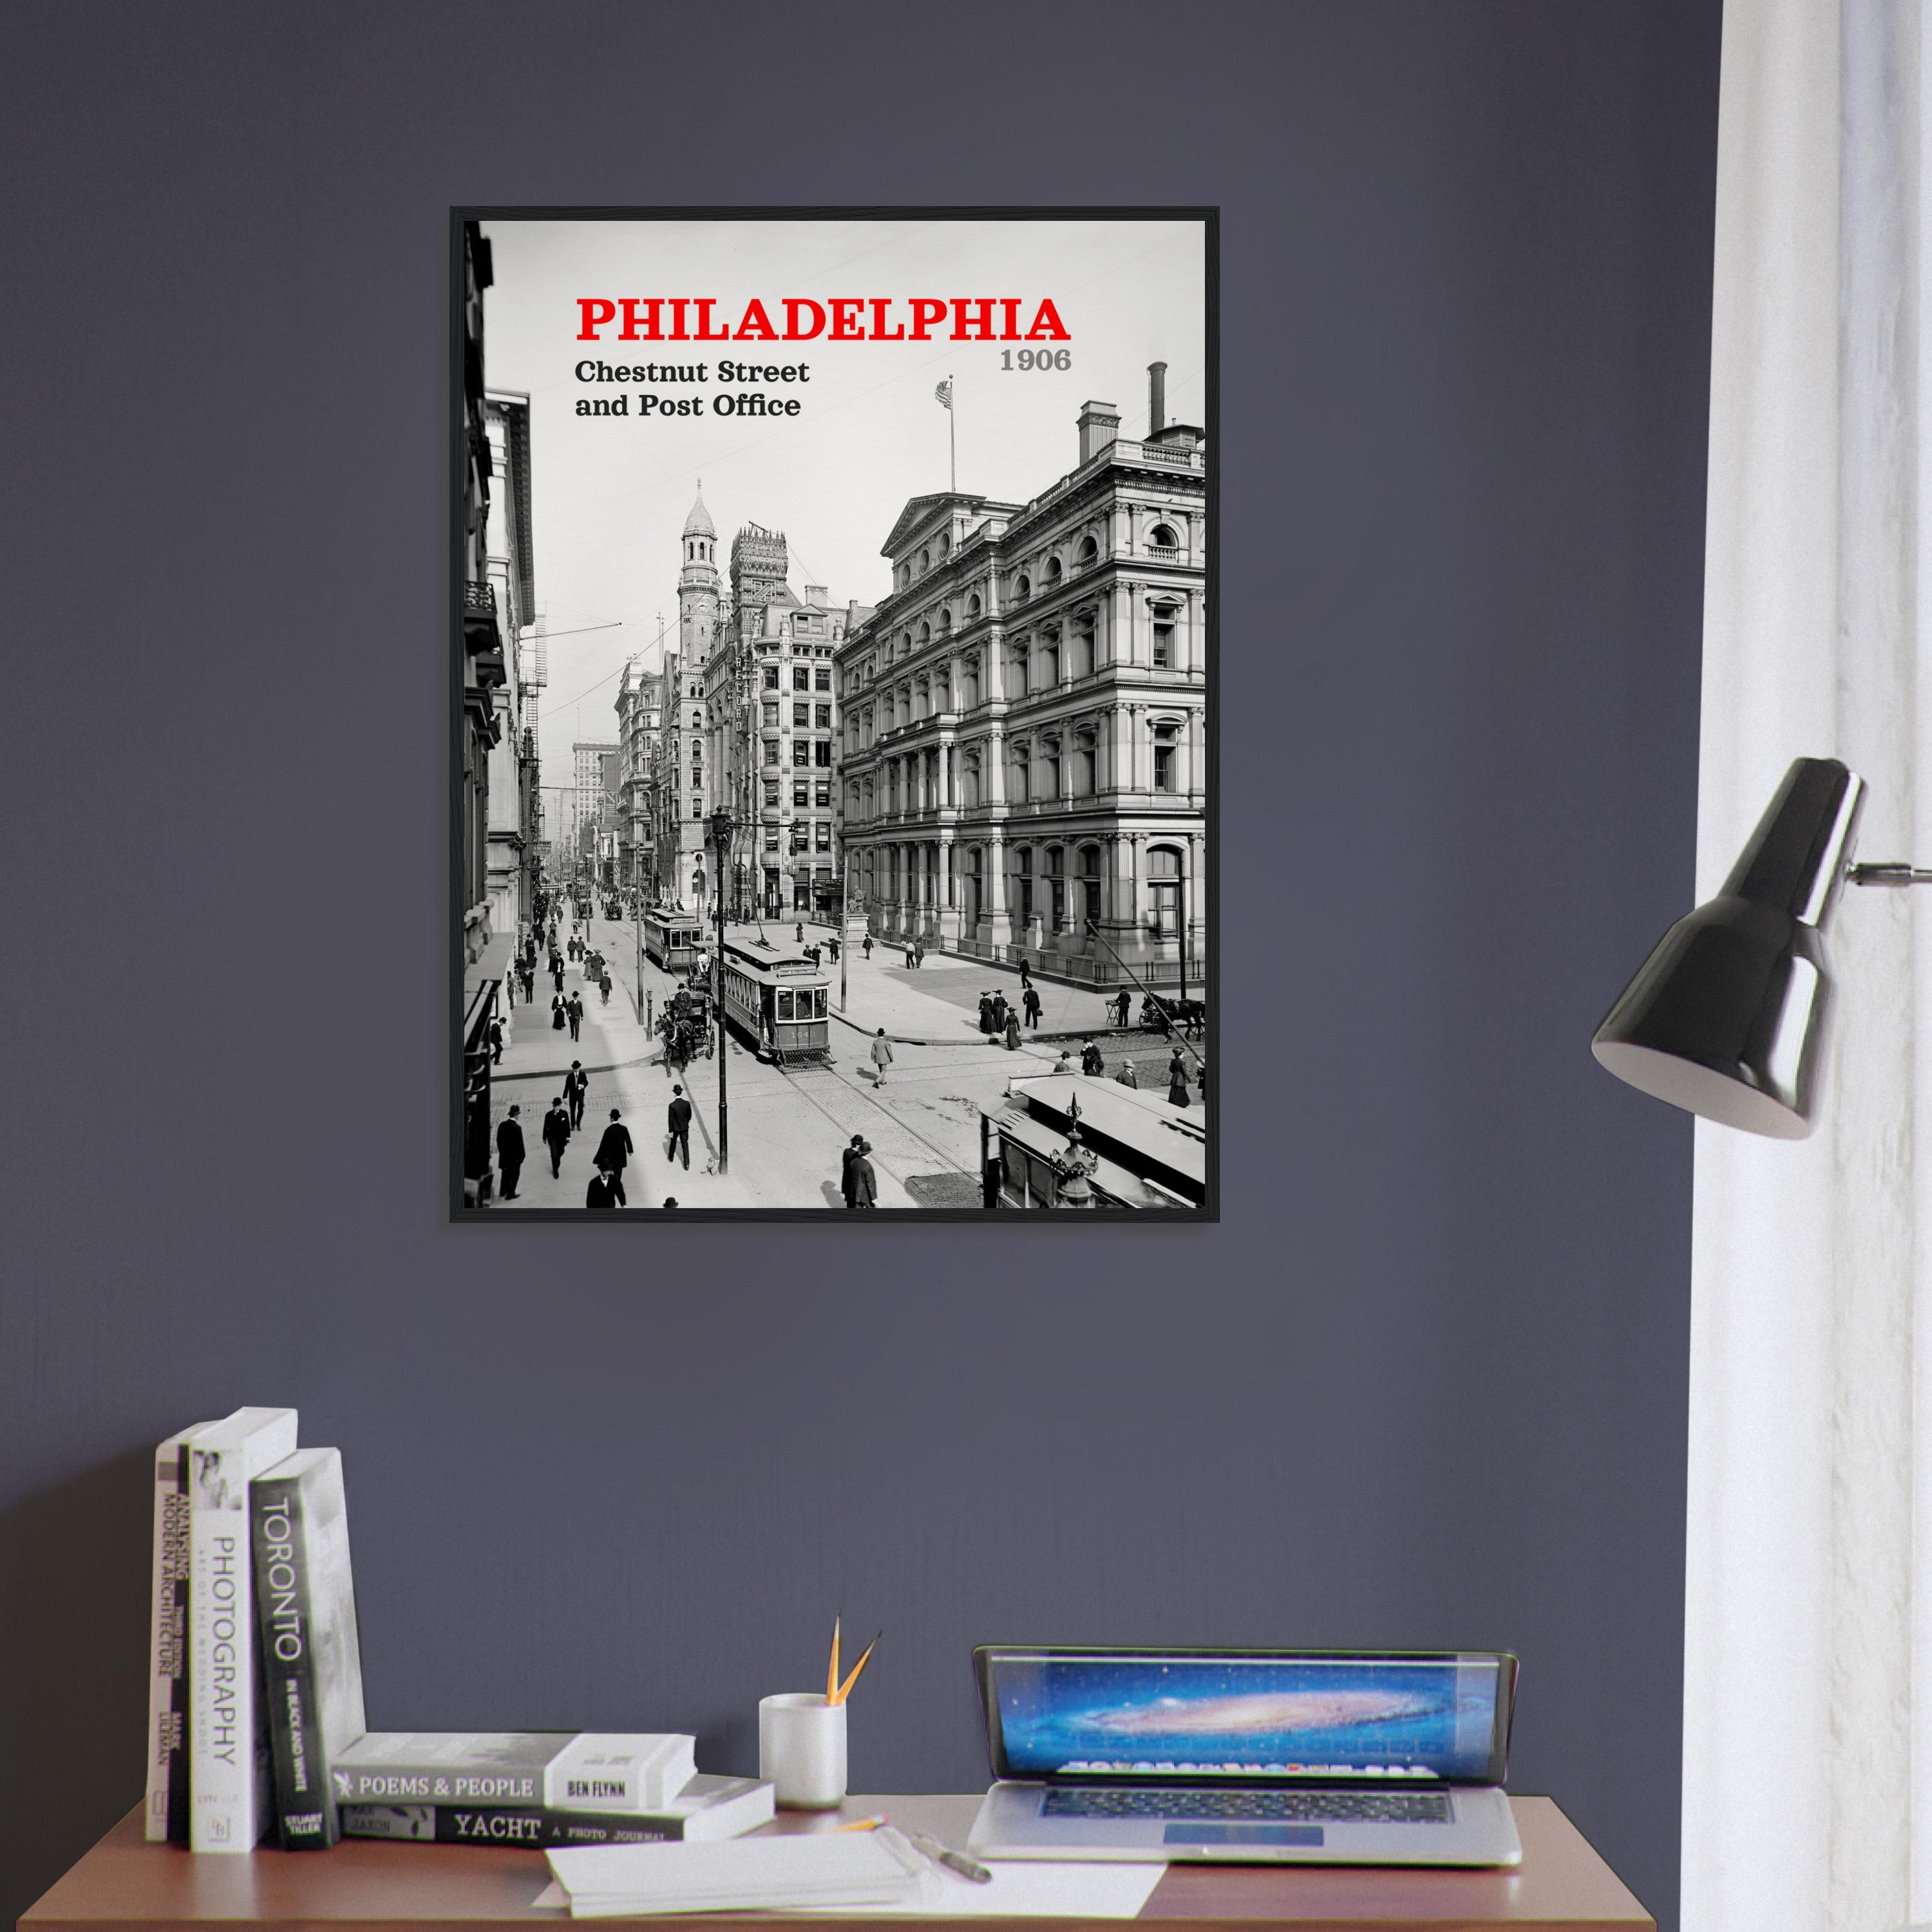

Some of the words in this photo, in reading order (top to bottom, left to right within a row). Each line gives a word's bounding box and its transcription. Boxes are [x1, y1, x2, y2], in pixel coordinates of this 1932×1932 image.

[576, 298, 1072, 341] PHILADELPHIA
[574, 360, 708, 383] Chestnut
[717, 360, 810, 383] Street
[1000, 349, 1072, 371] 1906
[575, 394, 629, 417] and
[638, 394, 704, 417] Post
[712, 393, 801, 417] Office
[162, 1492, 177, 1560] MODERN
[263, 1495, 302, 1661] TORONTO
[158, 1564, 175, 1677] ARCHITECTURE
[213, 1537, 236, 1766] PHOTOGRAPHY
[287, 1694, 302, 1728] BLACK
[292, 1730, 304, 1756] AND
[293, 1756, 308, 1792] WHITE
[360, 1777, 430, 1795] POEMS
[435, 1777, 451, 1795] &
[455, 1777, 534, 1797] PEOPLE
[567, 1781, 589, 1797] BEN
[454, 1814, 542, 1839] YACHT
[553, 1826, 560, 1839] A
[568, 1827, 607, 1839] PHOTO
